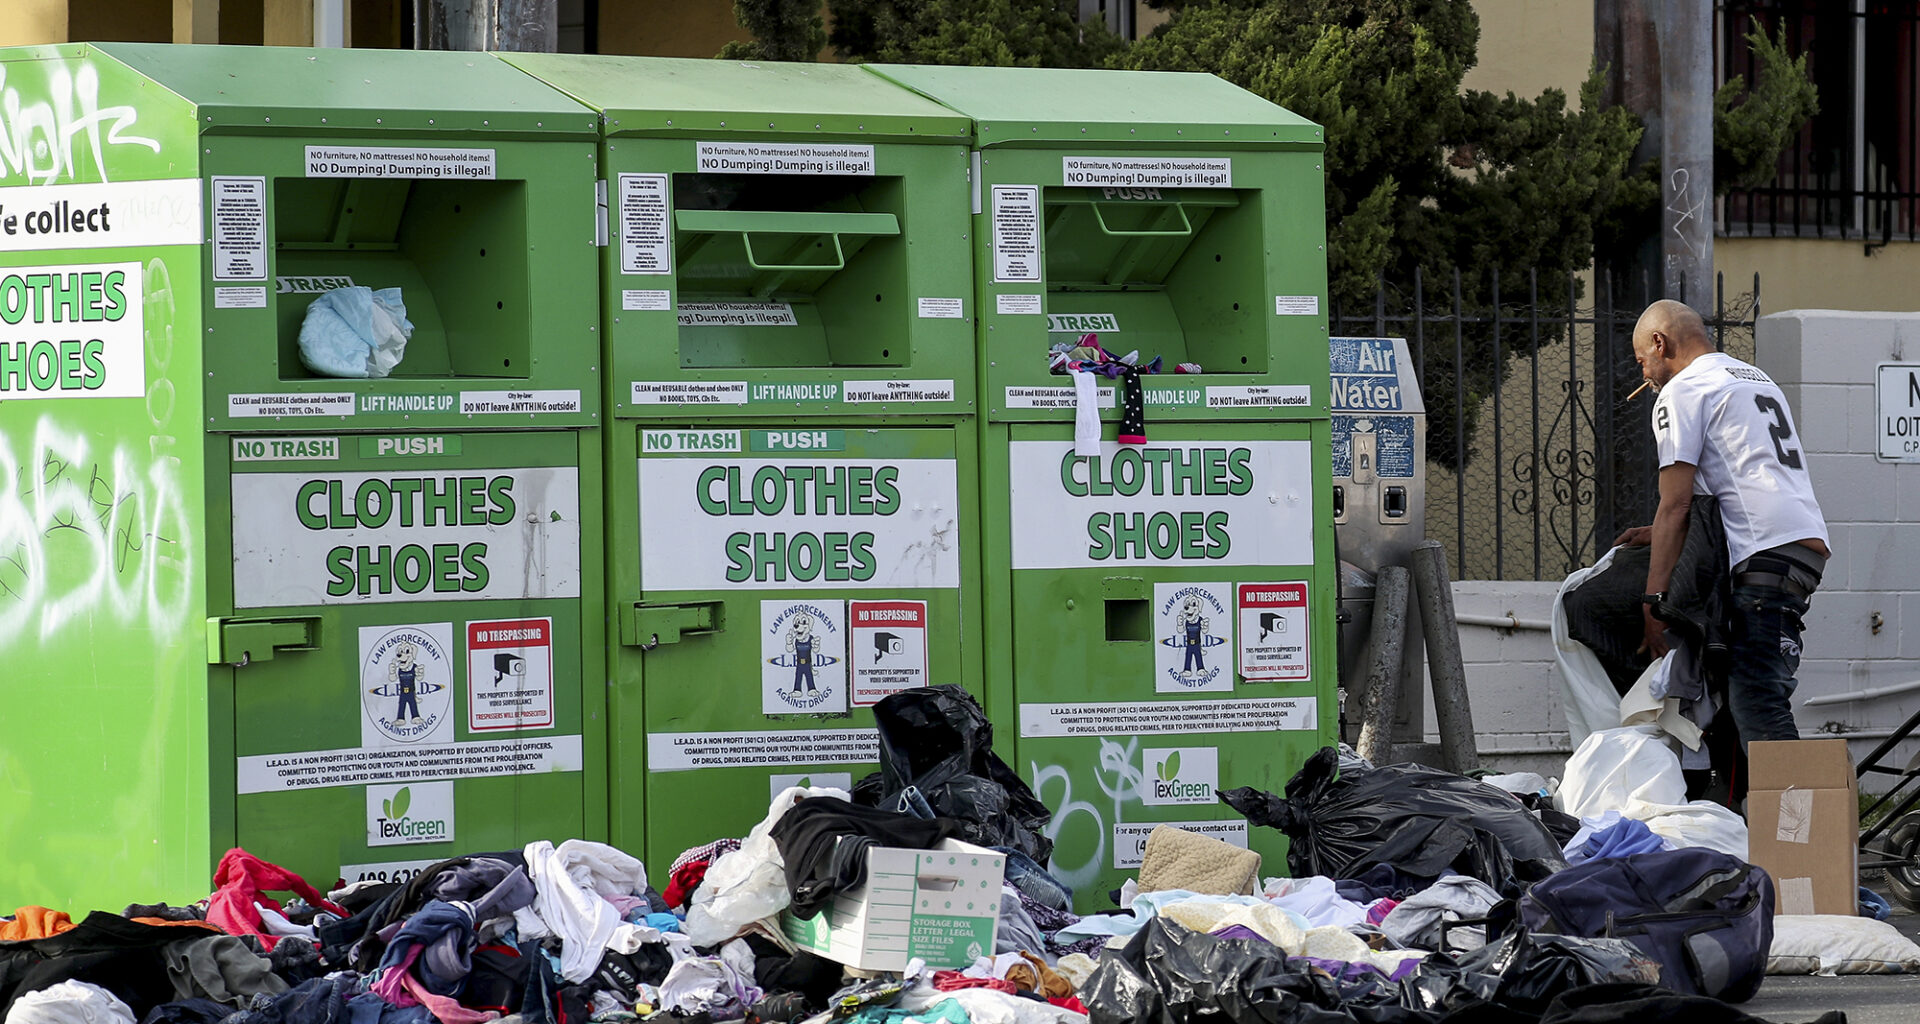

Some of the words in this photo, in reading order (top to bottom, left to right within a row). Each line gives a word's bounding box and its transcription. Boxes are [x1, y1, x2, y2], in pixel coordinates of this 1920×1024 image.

[310, 151, 322, 159] NO
[323, 151, 358, 159] furniture,
[429, 153, 467, 161] household
[714, 147, 746, 155] furniture,
[748, 147, 759, 155] NO
[760, 148, 798, 156] mattresses!
[800, 148, 811, 156] NO
[812, 148, 847, 157] household
[310, 162, 327, 172] NO
[330, 163, 385, 176] Dumping!
[389, 164, 440, 176] Dumping
[443, 164, 451, 174] is
[454, 164, 490, 177] illegal!
[702, 158, 718, 168] NO
[721, 158, 772, 171] Dumping!
[775, 159, 822, 172] Dumping
[825, 160, 833, 170] is
[835, 160, 869, 173] illegal!
[1079, 161, 1110, 169] furniture,
[1172, 162, 1205, 170] household
[1206, 162, 1225, 170] items!
[1068, 172, 1083, 182] NO
[1086, 172, 1134, 184] Dumping!
[1137, 173, 1182, 185] Dumping
[1184, 173, 1192, 182] is
[1194, 173, 1226, 185] illegal!
[0, 204, 17, 235] e
[25, 200, 110, 234] collect
[284, 278, 351, 290] TRASH
[695, 314, 745, 325] Dumping
[746, 314, 755, 322] is
[756, 313, 792, 324] illegal!
[1056, 316, 1115, 330] TRASH
[1358, 341, 1394, 372] Air
[753, 385, 775, 399] LIFT
[777, 384, 820, 399] HANDLE
[822, 384, 837, 398] UP
[847, 392, 856, 400] DO
[857, 391, 870, 400] NOT
[871, 391, 888, 400] leave
[889, 391, 923, 400] ANYTHING
[924, 390, 949, 401] outside!
[1143, 390, 1184, 404] HANDLE
[1186, 390, 1200, 403] UP
[361, 396, 385, 410] LIFT
[388, 395, 434, 410] HANDLE
[437, 395, 453, 410] UP
[464, 402, 474, 411] DO
[475, 402, 489, 411] NOT
[490, 402, 509, 411] leave
[510, 402, 546, 410] ANYTHING
[548, 401, 576, 412] outside!
[1658, 406, 1670, 430] 2
[647, 433, 672, 449] NO
[677, 432, 736, 449] TRASH
[767, 431, 827, 448] PUSH
[1754, 393, 1803, 471] 2
[237, 441, 265, 457] NO
[270, 440, 333, 457] TRASH
[378, 437, 443, 454] PUSH
[1060, 448, 1254, 497] CLOTHES
[696, 465, 901, 516] CLOTHES
[295, 476, 516, 530] CLOTHES
[1087, 511, 1231, 560] SHOES
[725, 532, 877, 582] SHOES
[326, 542, 490, 596] SHOES
[1162, 597, 1176, 617] LAW
[1175, 587, 1224, 615] ENFORCEMENT
[1246, 591, 1255, 601] NO
[1256, 591, 1299, 601] TRESPASSING
[770, 614, 784, 635] LAW
[784, 604, 836, 634] ENFORCEMENT
[858, 610, 869, 620] NO
[870, 609, 917, 620] TRESPASSING
[476, 630, 487, 642] NO
[489, 628, 541, 641] TRESPASSING
[371, 645, 386, 665] LAW
[386, 634, 440, 661] ENFORCEMENT
[1168, 667, 1196, 687] AGAINST
[1198, 666, 1220, 687] DRUGS
[776, 687, 807, 708] AGAINST
[808, 686, 833, 708] DRUGS
[378, 717, 411, 736] AGAINST
[412, 713, 437, 736] DRUGS
[266, 759, 290, 767] L.E.A.D.
[304, 756, 318, 764] NON
[319, 754, 342, 763] PROFIT
[343, 752, 367, 761] (501C3)
[368, 750, 417, 759] ORGANIZATION,
[418, 748, 455, 756] SUPPORTED
[465, 745, 499, 754] DEDICATED
[500, 744, 522, 752] POLICE
[522, 742, 552, 750] OFFICERS,
[277, 767, 316, 776] COMMITTED
[327, 763, 366, 772] PROTECTING
[382, 760, 403, 768] YOUTH
[419, 757, 463, 766] COMMUNITIES
[464, 756, 482, 764] FROM
[483, 755, 494, 763] THE
[496, 752, 542, 762] PROLIFERATION
[286, 778, 295, 786] OF
[296, 777, 320, 785] DRUGS,
[321, 775, 340, 783] DRUG
[340, 773, 368, 781] RELATED
[369, 771, 394, 779] CRIMES,
[395, 770, 410, 778] PEER
[420, 767, 458, 776] PEER/CYBER
[458, 766, 488, 774] BULLYING
[504, 763, 535, 772] VIOLENCE.
[1153, 778, 1210, 798] TexGreen
[377, 816, 445, 838] TexGreen
[1128, 826, 1141, 836] any
[1202, 824, 1227, 832] contact
[913, 918, 952, 928] STORAGE
[953, 920, 971, 928] BOX
[913, 927, 943, 935] LETTER
[949, 928, 975, 937] LEGAL
